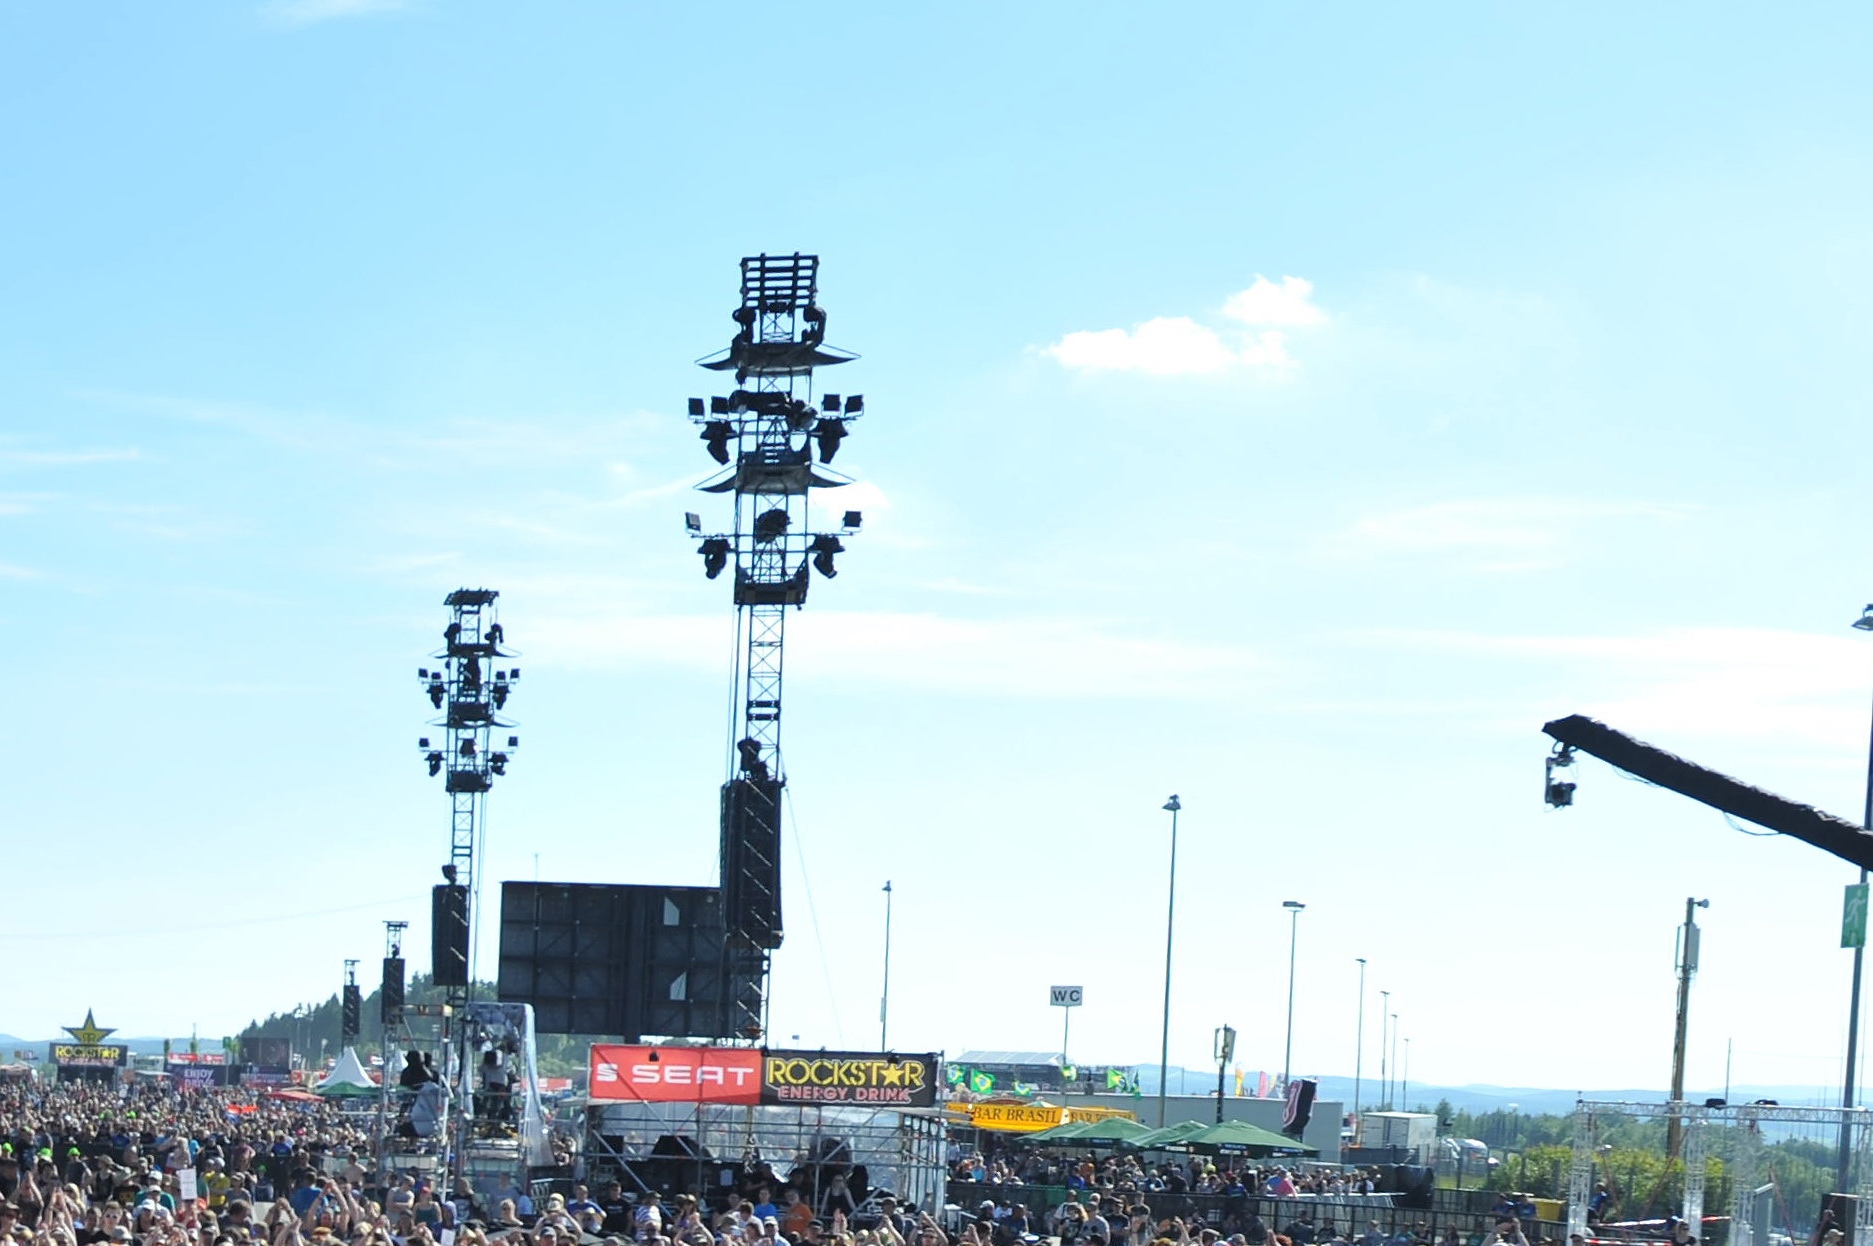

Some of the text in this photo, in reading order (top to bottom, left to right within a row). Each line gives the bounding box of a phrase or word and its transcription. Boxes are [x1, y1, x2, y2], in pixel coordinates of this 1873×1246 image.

[1053, 990, 1080, 1002] WC
[632, 1065, 754, 1086] SEAT
[768, 1060, 924, 1086] ROCKSTAR
[778, 1086, 910, 1101] ENERGY DRINK
[975, 1108, 1060, 1123] BAR BRASIL
